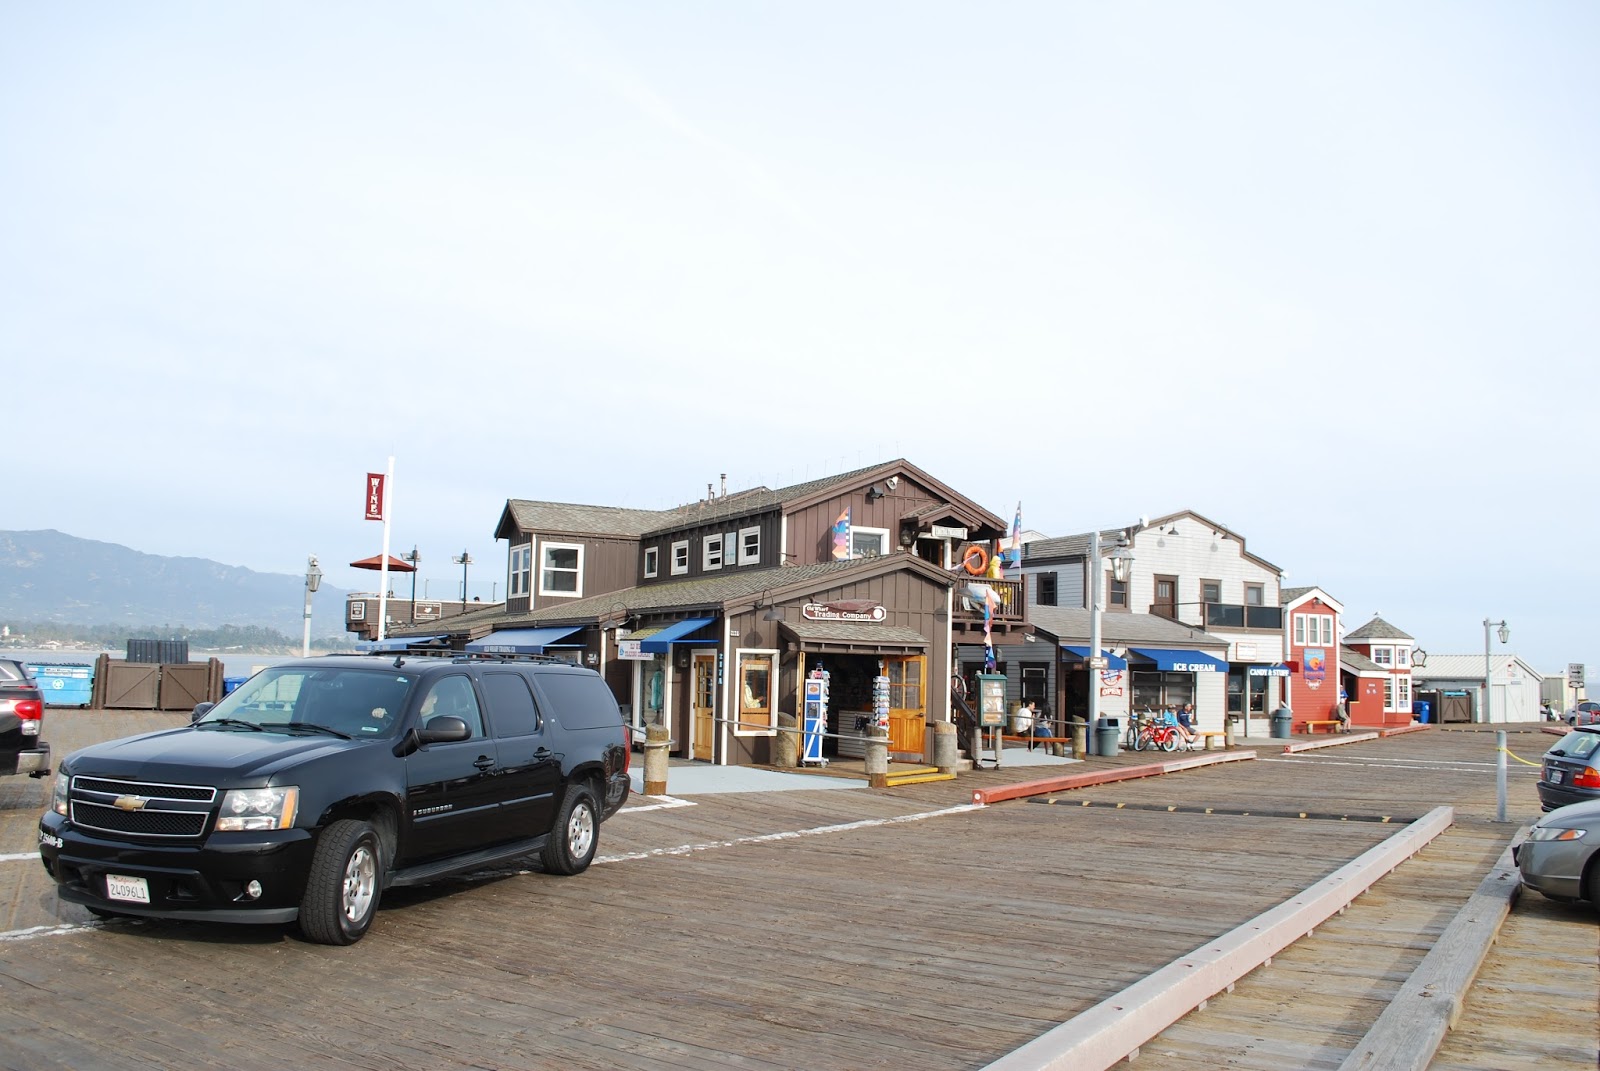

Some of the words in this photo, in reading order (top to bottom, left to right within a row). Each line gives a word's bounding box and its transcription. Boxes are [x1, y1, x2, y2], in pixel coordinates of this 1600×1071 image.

[370, 477, 380, 514] WINE
[814, 611, 840, 619] Trading
[842, 611, 872, 619] Company
[1173, 663, 1187, 671] ICE
[1188, 663, 1216, 672] CREAM
[1101, 688, 1121, 696] OPEN
[110, 883, 147, 899] 24096L1
